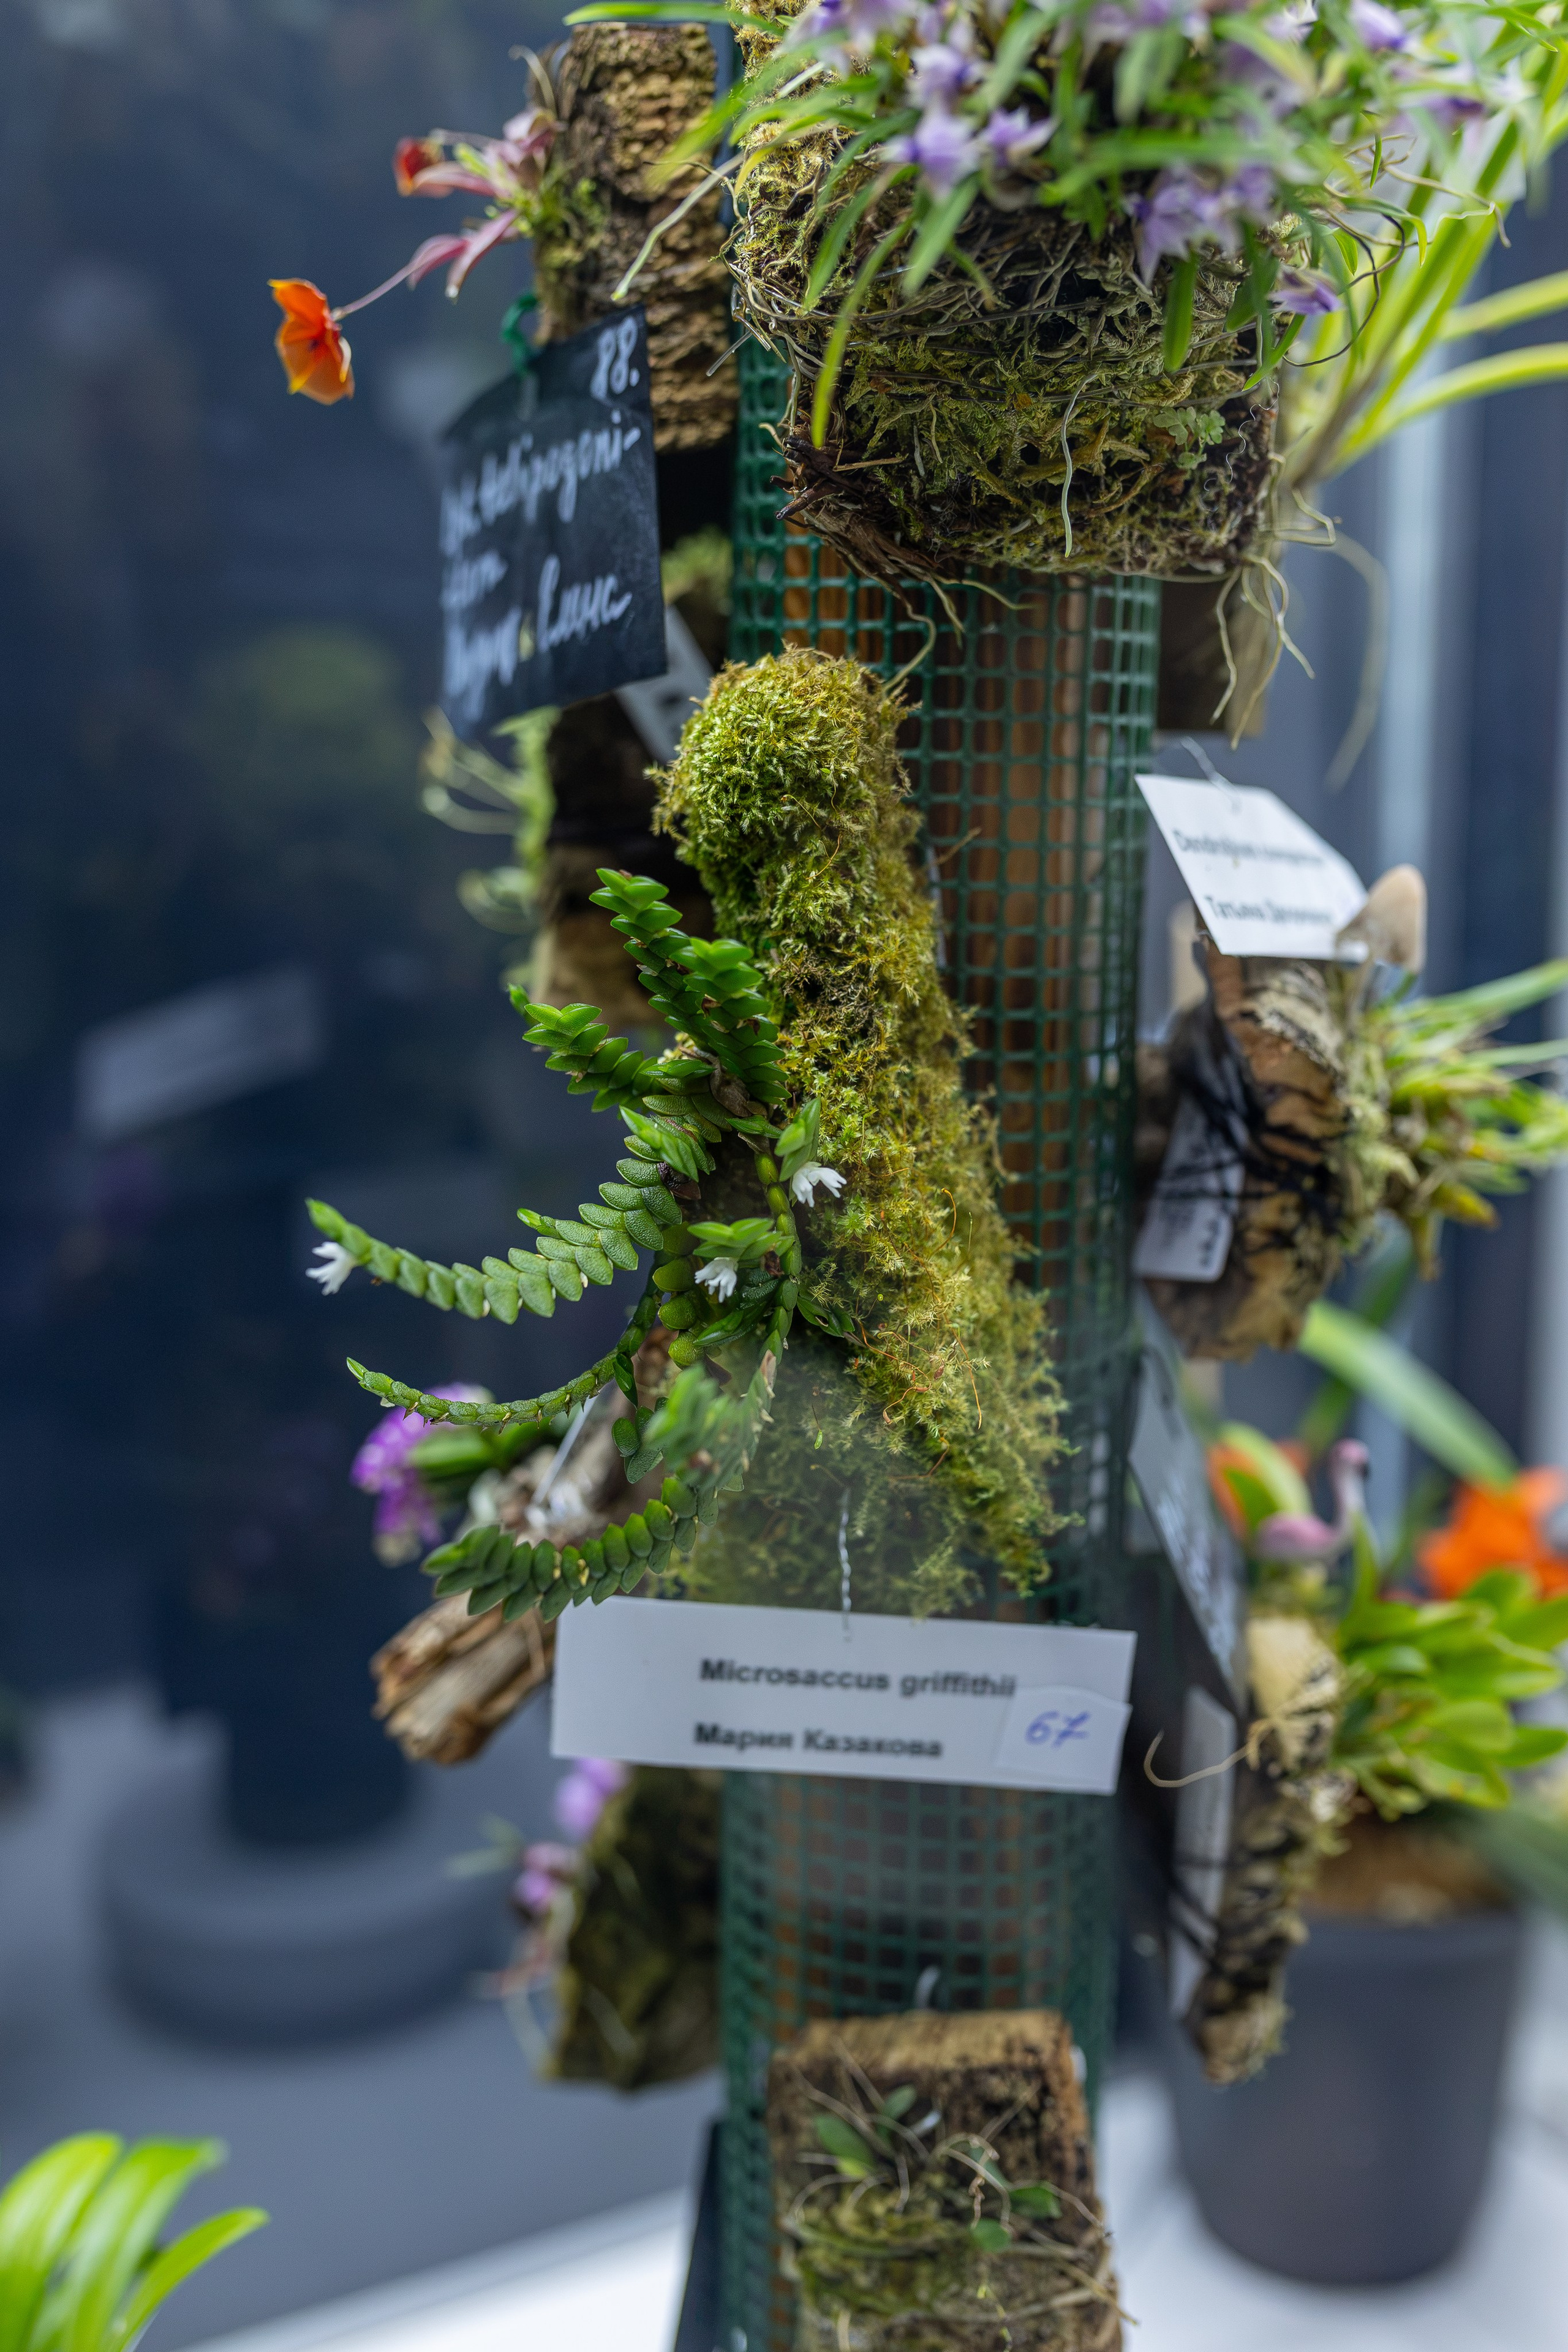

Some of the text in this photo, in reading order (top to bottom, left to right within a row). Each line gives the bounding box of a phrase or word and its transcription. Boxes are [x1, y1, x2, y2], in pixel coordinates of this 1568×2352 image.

[699, 1657, 1018, 1698] Microsaccus griffithii
[693, 1722, 944, 1758] Мария Казакова
[1025, 1709, 1093, 1748] 67
